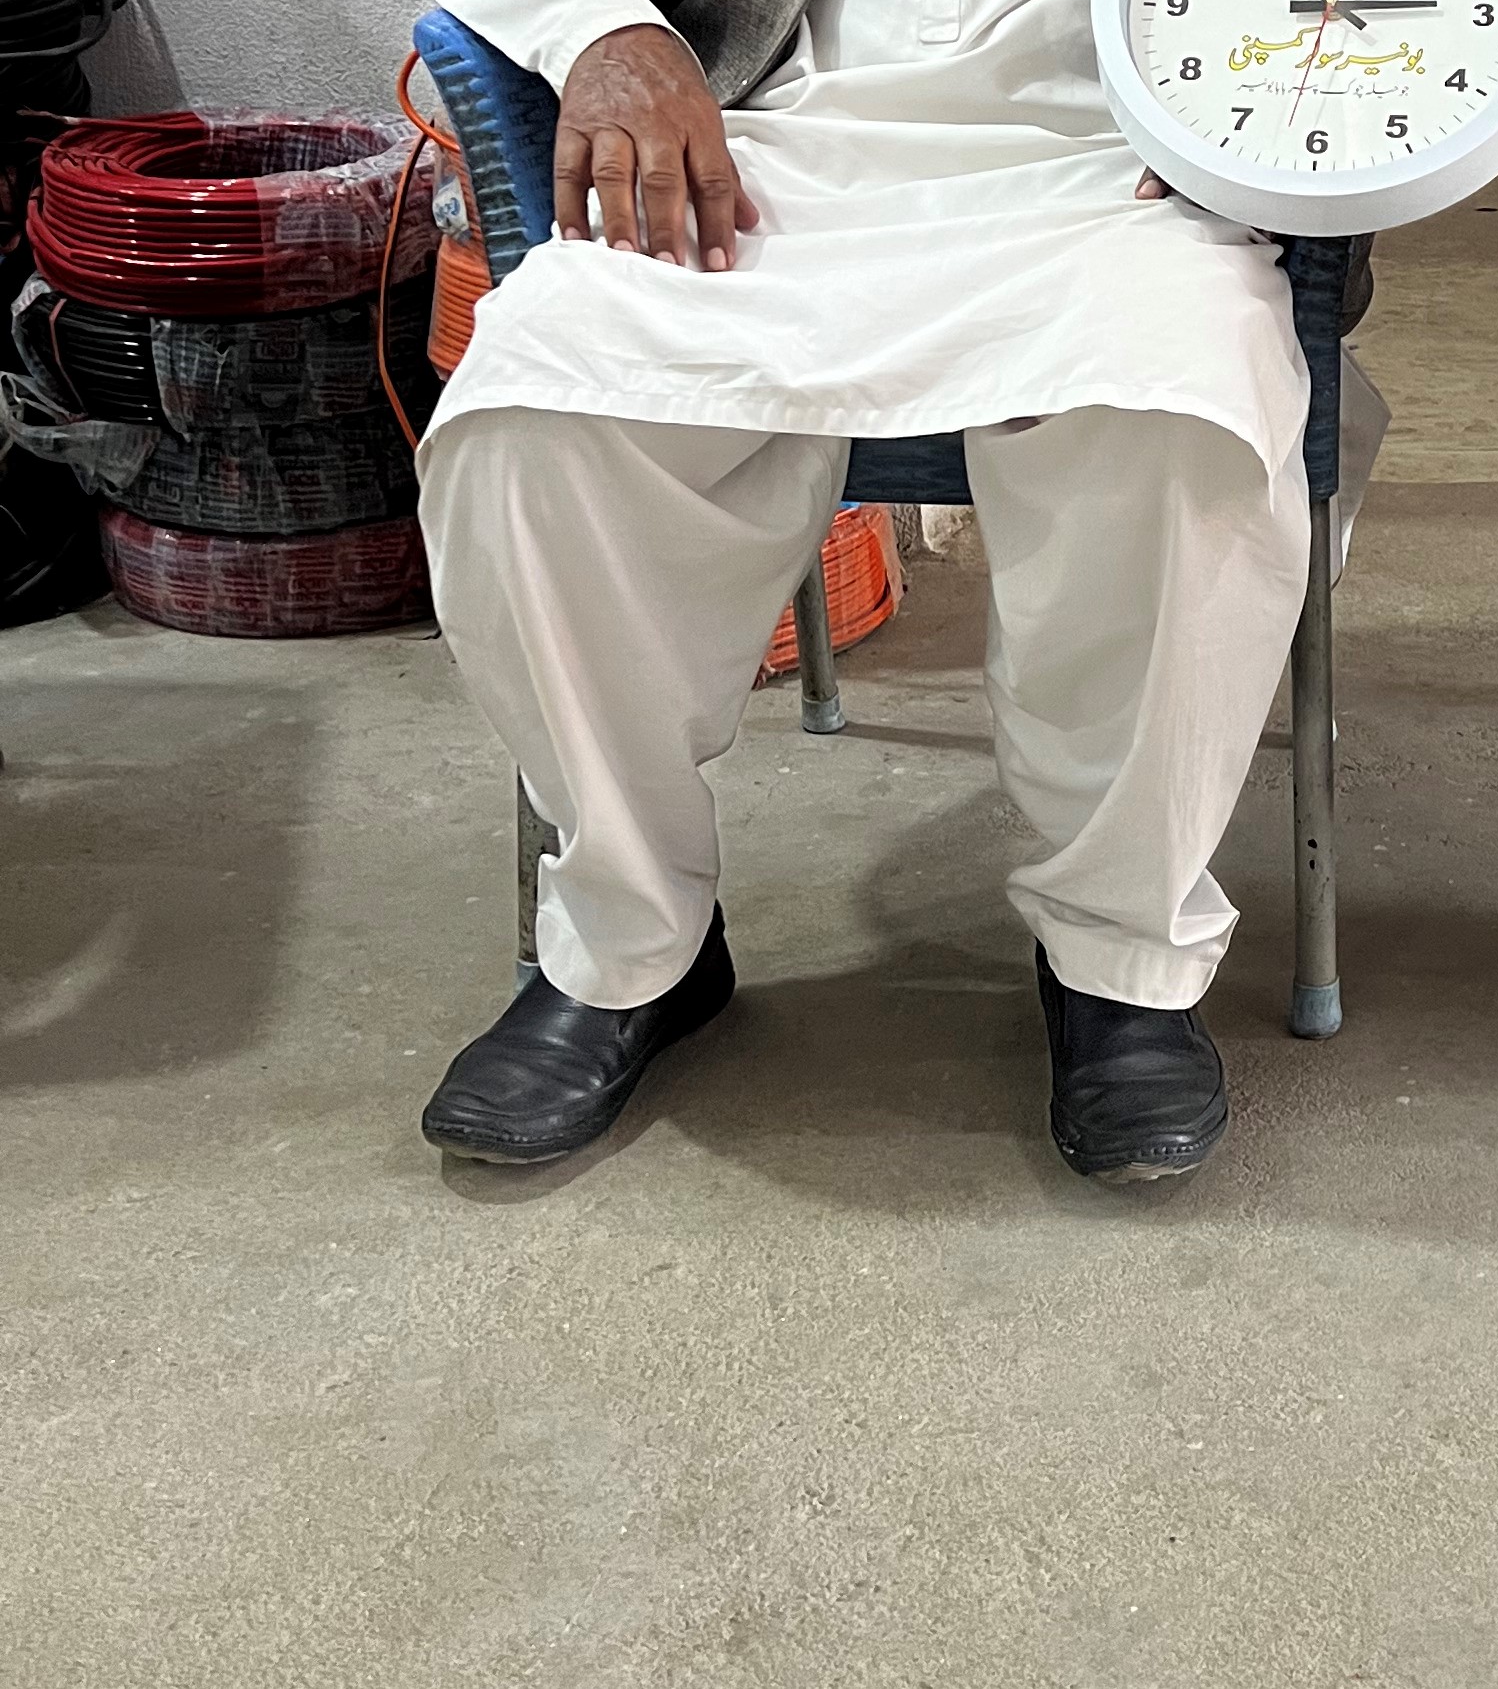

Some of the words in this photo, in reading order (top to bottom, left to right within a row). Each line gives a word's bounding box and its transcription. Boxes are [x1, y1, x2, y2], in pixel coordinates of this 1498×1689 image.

[1473, 3, 1495, 26] 3
[1180, 57, 1202, 80] 8
[1445, 69, 1468, 91] 4
[1231, 107, 1254, 130] 7
[1385, 115, 1408, 138] 5
[1306, 131, 1328, 154] 6
